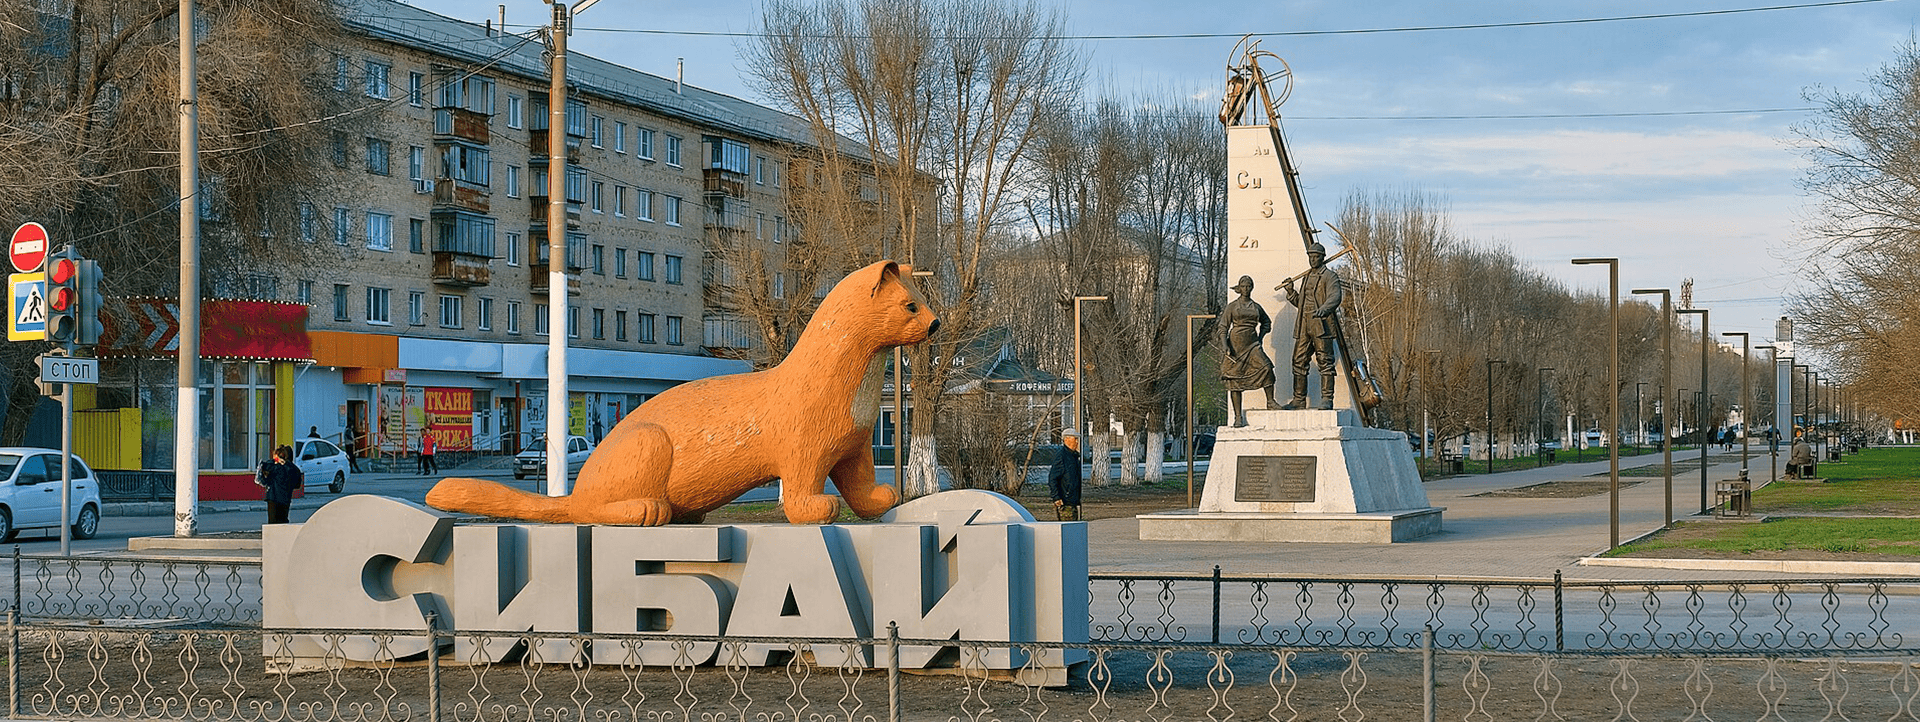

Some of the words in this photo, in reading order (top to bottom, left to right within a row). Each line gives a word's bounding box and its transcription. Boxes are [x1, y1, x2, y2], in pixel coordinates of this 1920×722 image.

[1253, 146, 1270, 156] Au
[1237, 170, 1262, 189] Cu
[1261, 199, 1274, 219] S
[1239, 236, 1259, 249] Zn
[51, 362, 90, 379] СТОП
[1016, 381, 1052, 391] КОФЕЙНЯ
[1056, 382, 1075, 391] ДЕСЕР
[426, 391, 471, 411] ТКАНИ
[431, 429, 471, 447] РЯЖА
[288, 491, 1019, 669] СИБАЙ
